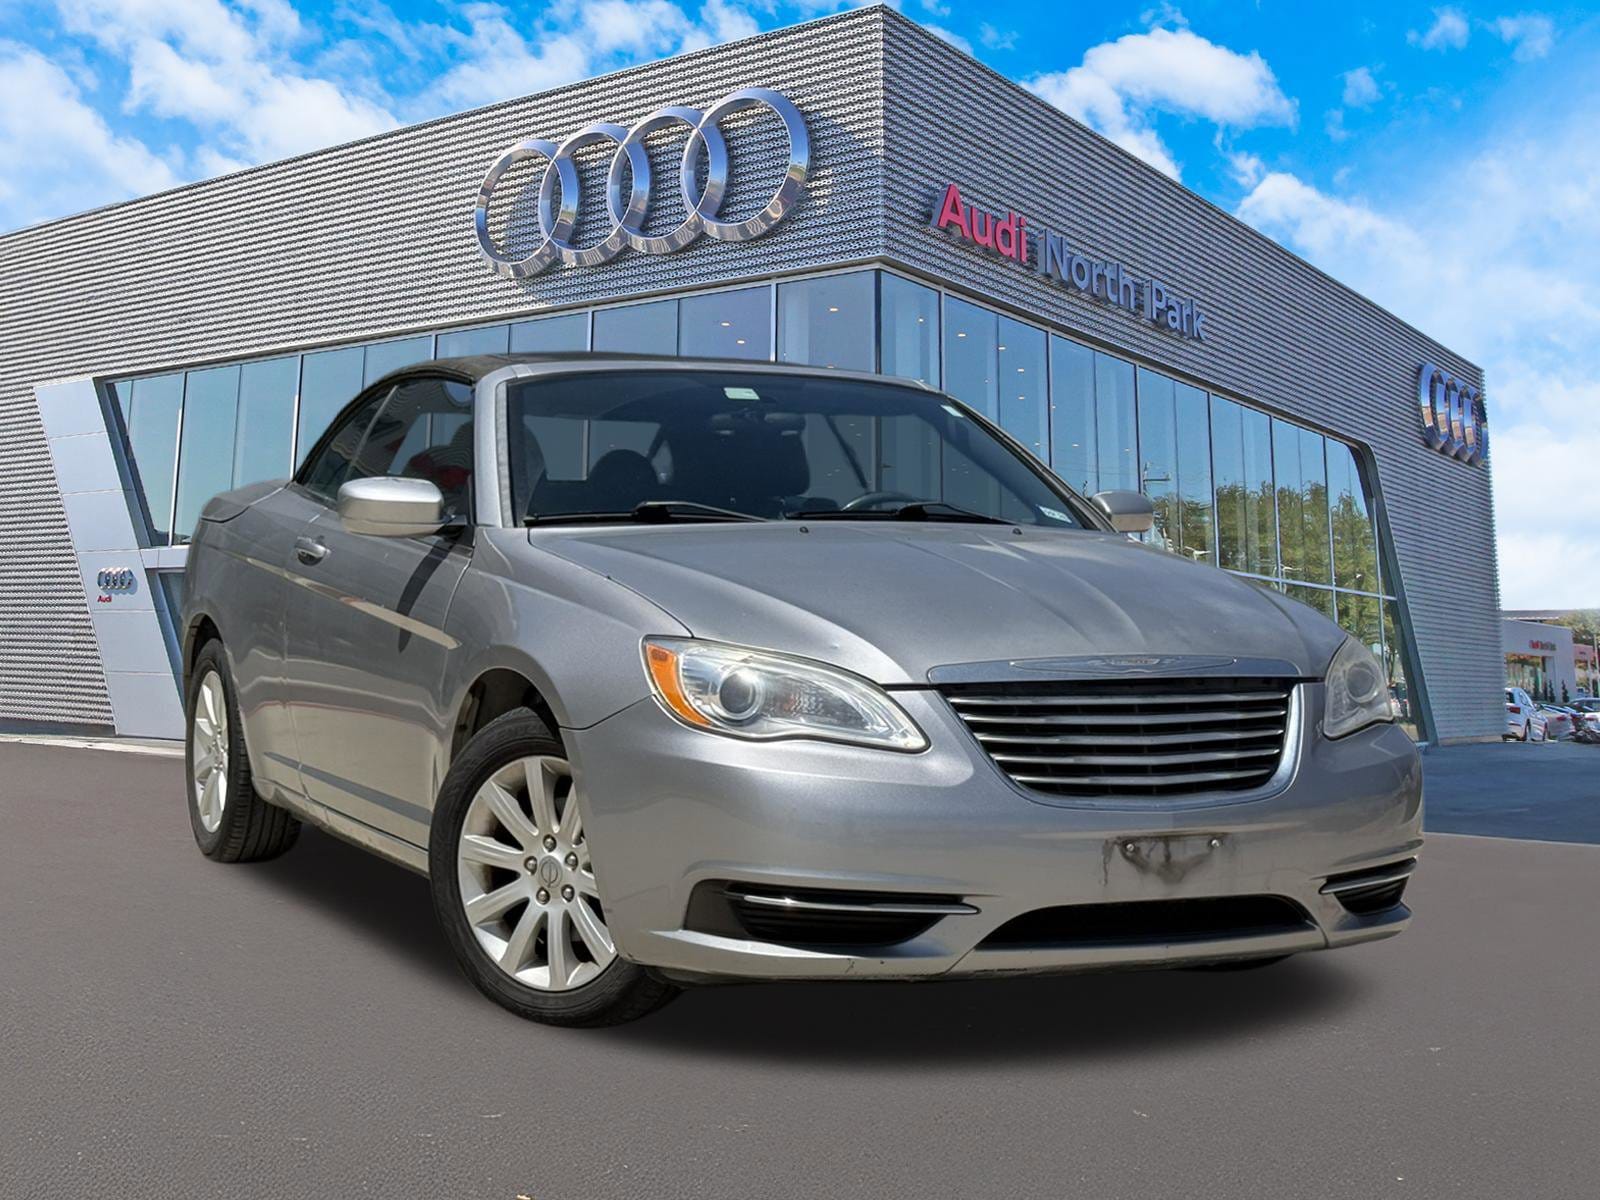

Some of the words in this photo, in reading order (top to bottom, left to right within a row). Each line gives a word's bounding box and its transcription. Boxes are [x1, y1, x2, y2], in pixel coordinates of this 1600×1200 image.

[935, 183, 1028, 263] Audi
[1040, 230, 1136, 311] North
[1147, 278, 1208, 340] Park
[97, 595, 112, 603] Audi
